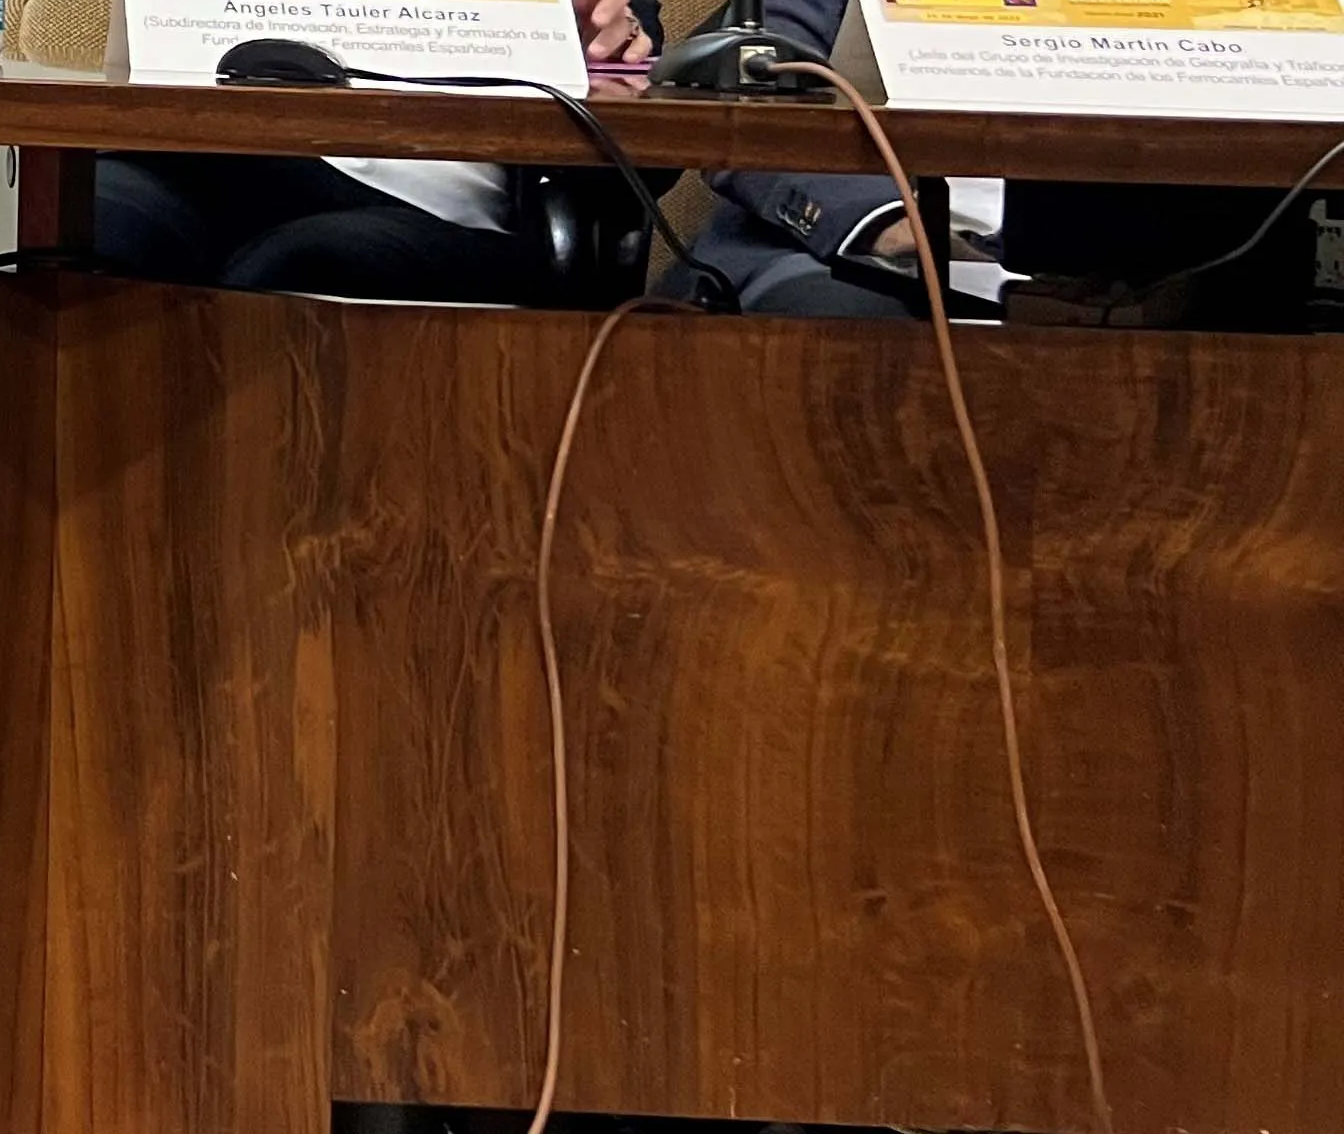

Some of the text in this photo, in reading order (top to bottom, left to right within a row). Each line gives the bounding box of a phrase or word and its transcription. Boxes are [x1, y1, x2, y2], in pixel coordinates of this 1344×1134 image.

[320, 3, 393, 18] Táuler
[398, 6, 481, 22] Alcaraz
[143, 15, 242, 31] (Subdirectora
[245, 19, 265, 31] de
[356, 22, 431, 38] Estrategia
[431, 27, 444, 39] y
[447, 25, 527, 40] Formación
[530, 29, 551, 41] de
[553, 30, 567, 42] la
[428, 40, 513, 58] Españoles)
[1001, 33, 1082, 51] Sergio
[1178, 39, 1243, 53] Cabo
[952, 50, 975, 61] del
[979, 50, 1029, 65] Grupo
[1032, 52, 1053, 64] de
[1164, 56, 1185, 67] de
[1270, 60, 1282, 73] y
[993, 65, 1015, 77] de
[1018, 65, 1034, 78] la
[1126, 70, 1146, 82] de
[1150, 71, 1174, 83] los
